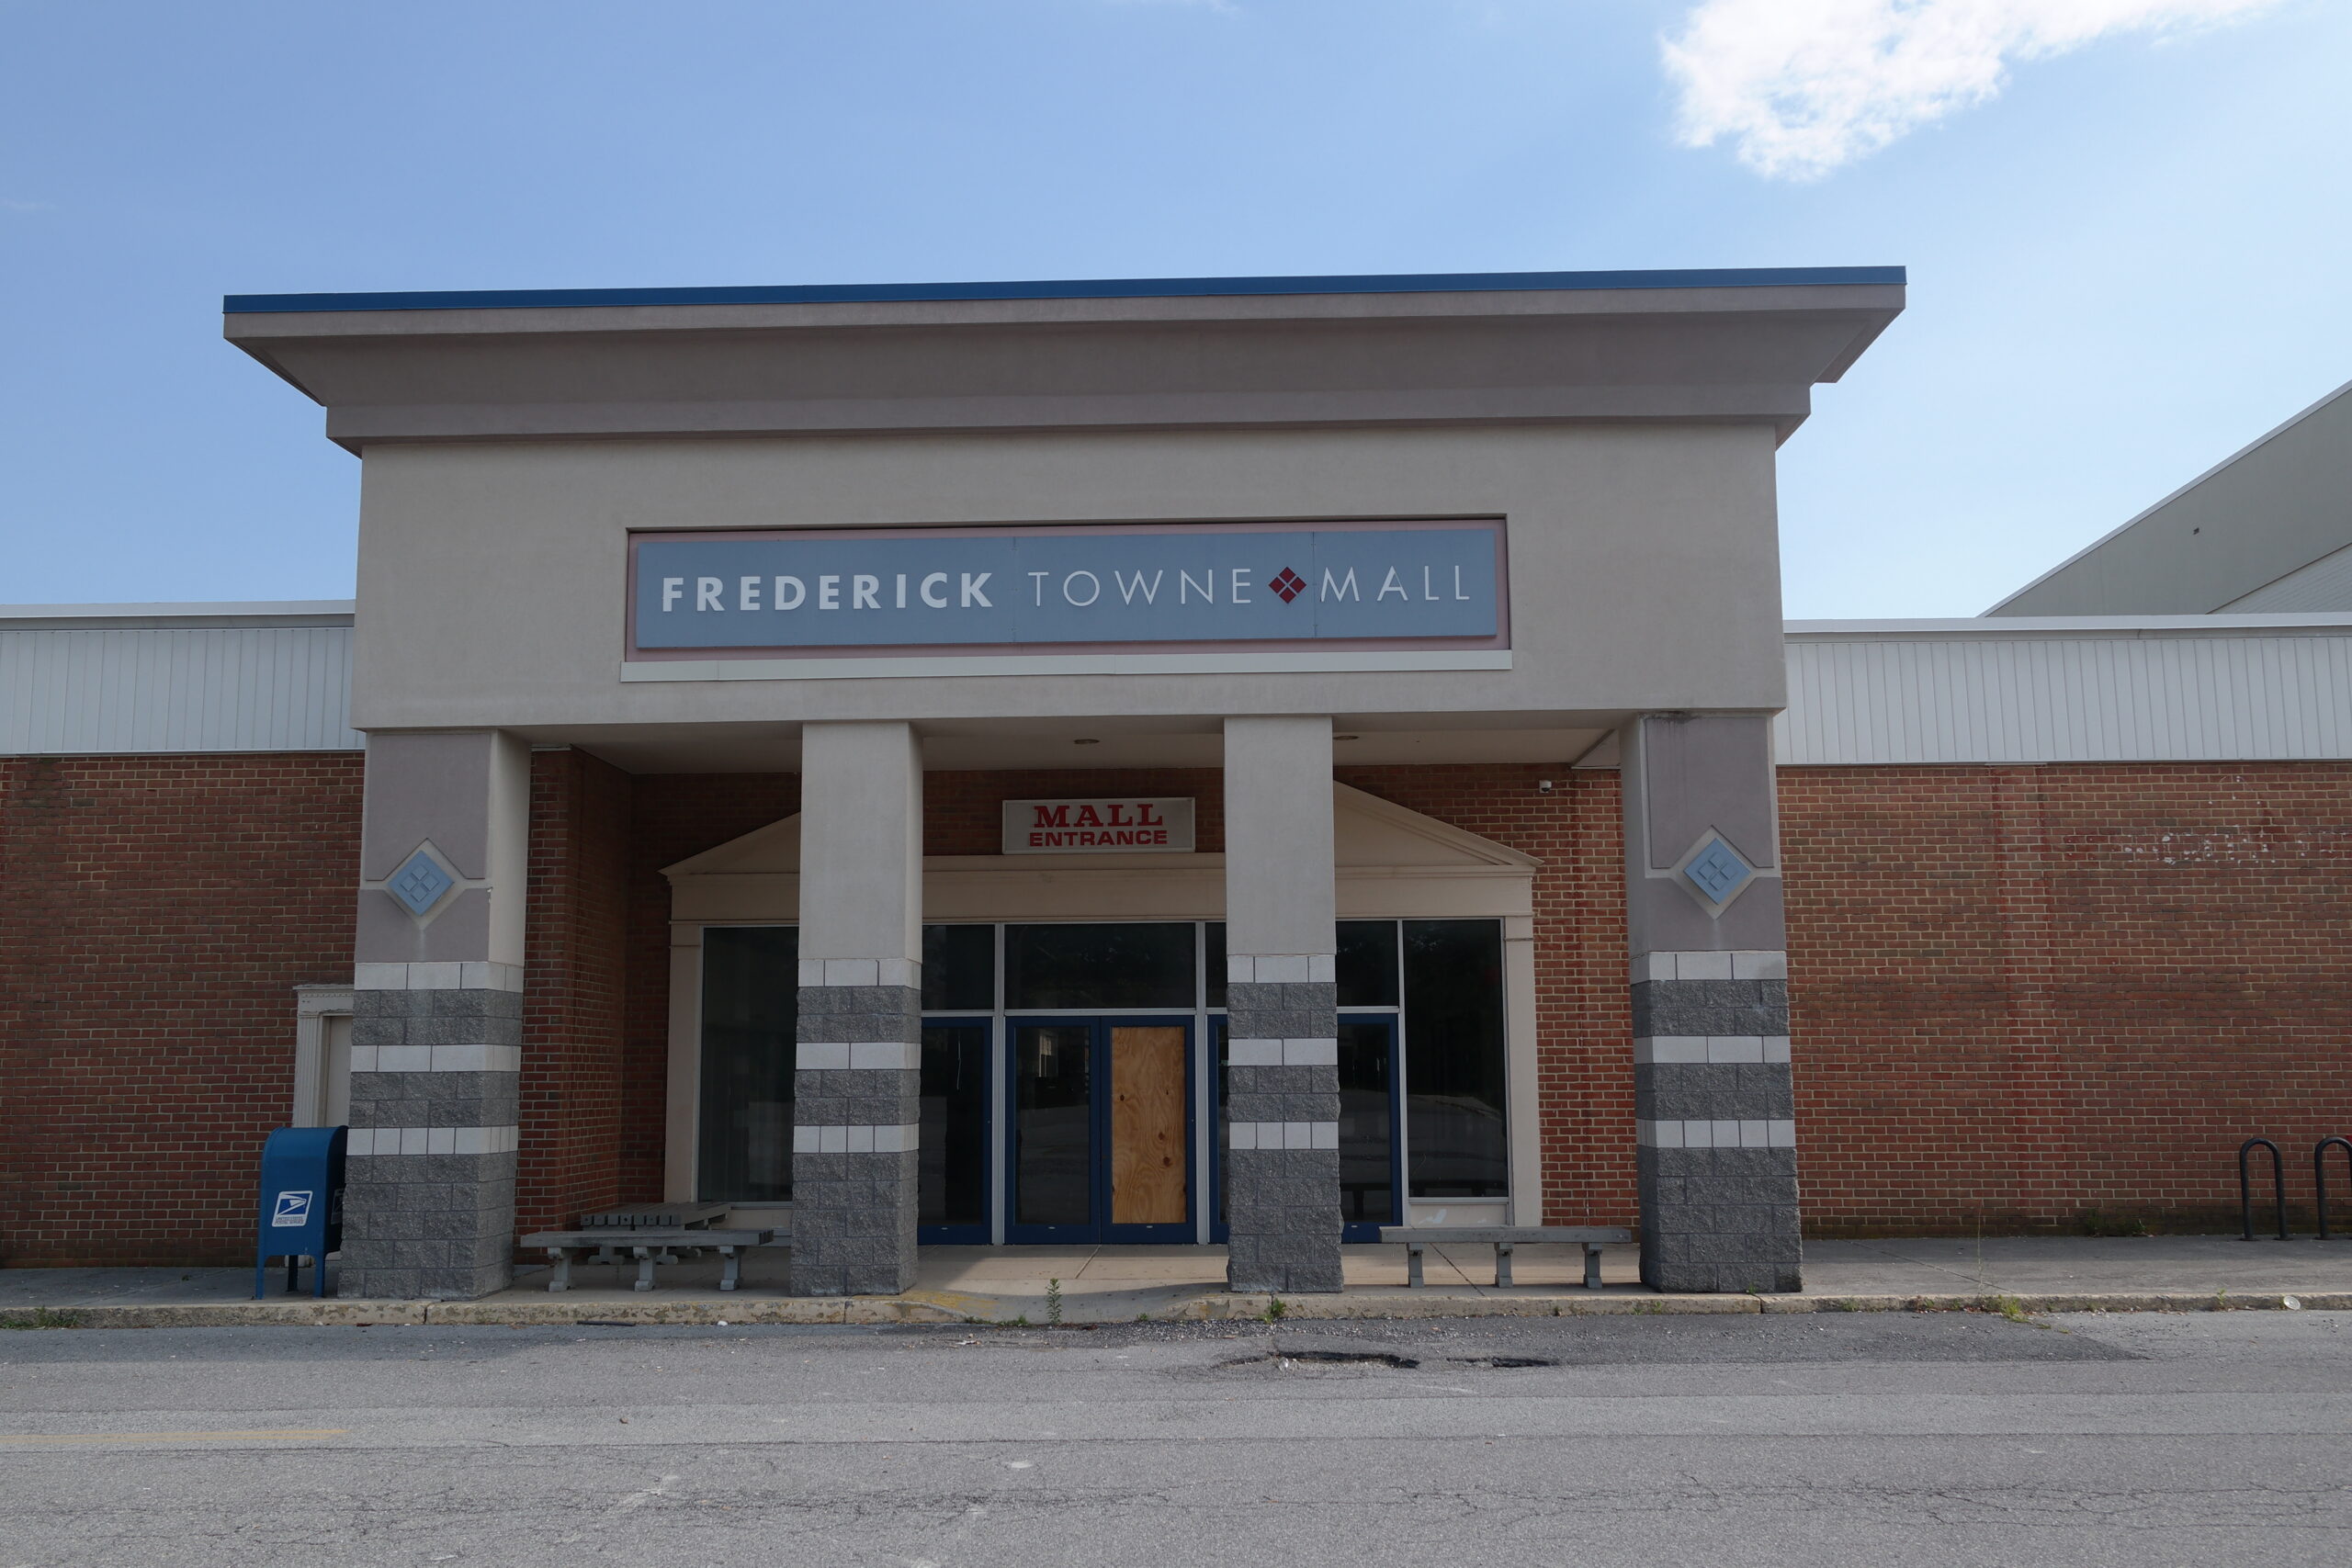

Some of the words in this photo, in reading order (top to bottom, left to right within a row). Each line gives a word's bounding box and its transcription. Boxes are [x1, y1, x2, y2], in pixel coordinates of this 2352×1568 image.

[662, 571, 992, 612] FREDERICK
[1028, 568, 1251, 607] TOWNE
[1320, 564, 1471, 603] MALL
[1034, 804, 1163, 828] MALL
[1029, 830, 1168, 846] ENTRANCE
